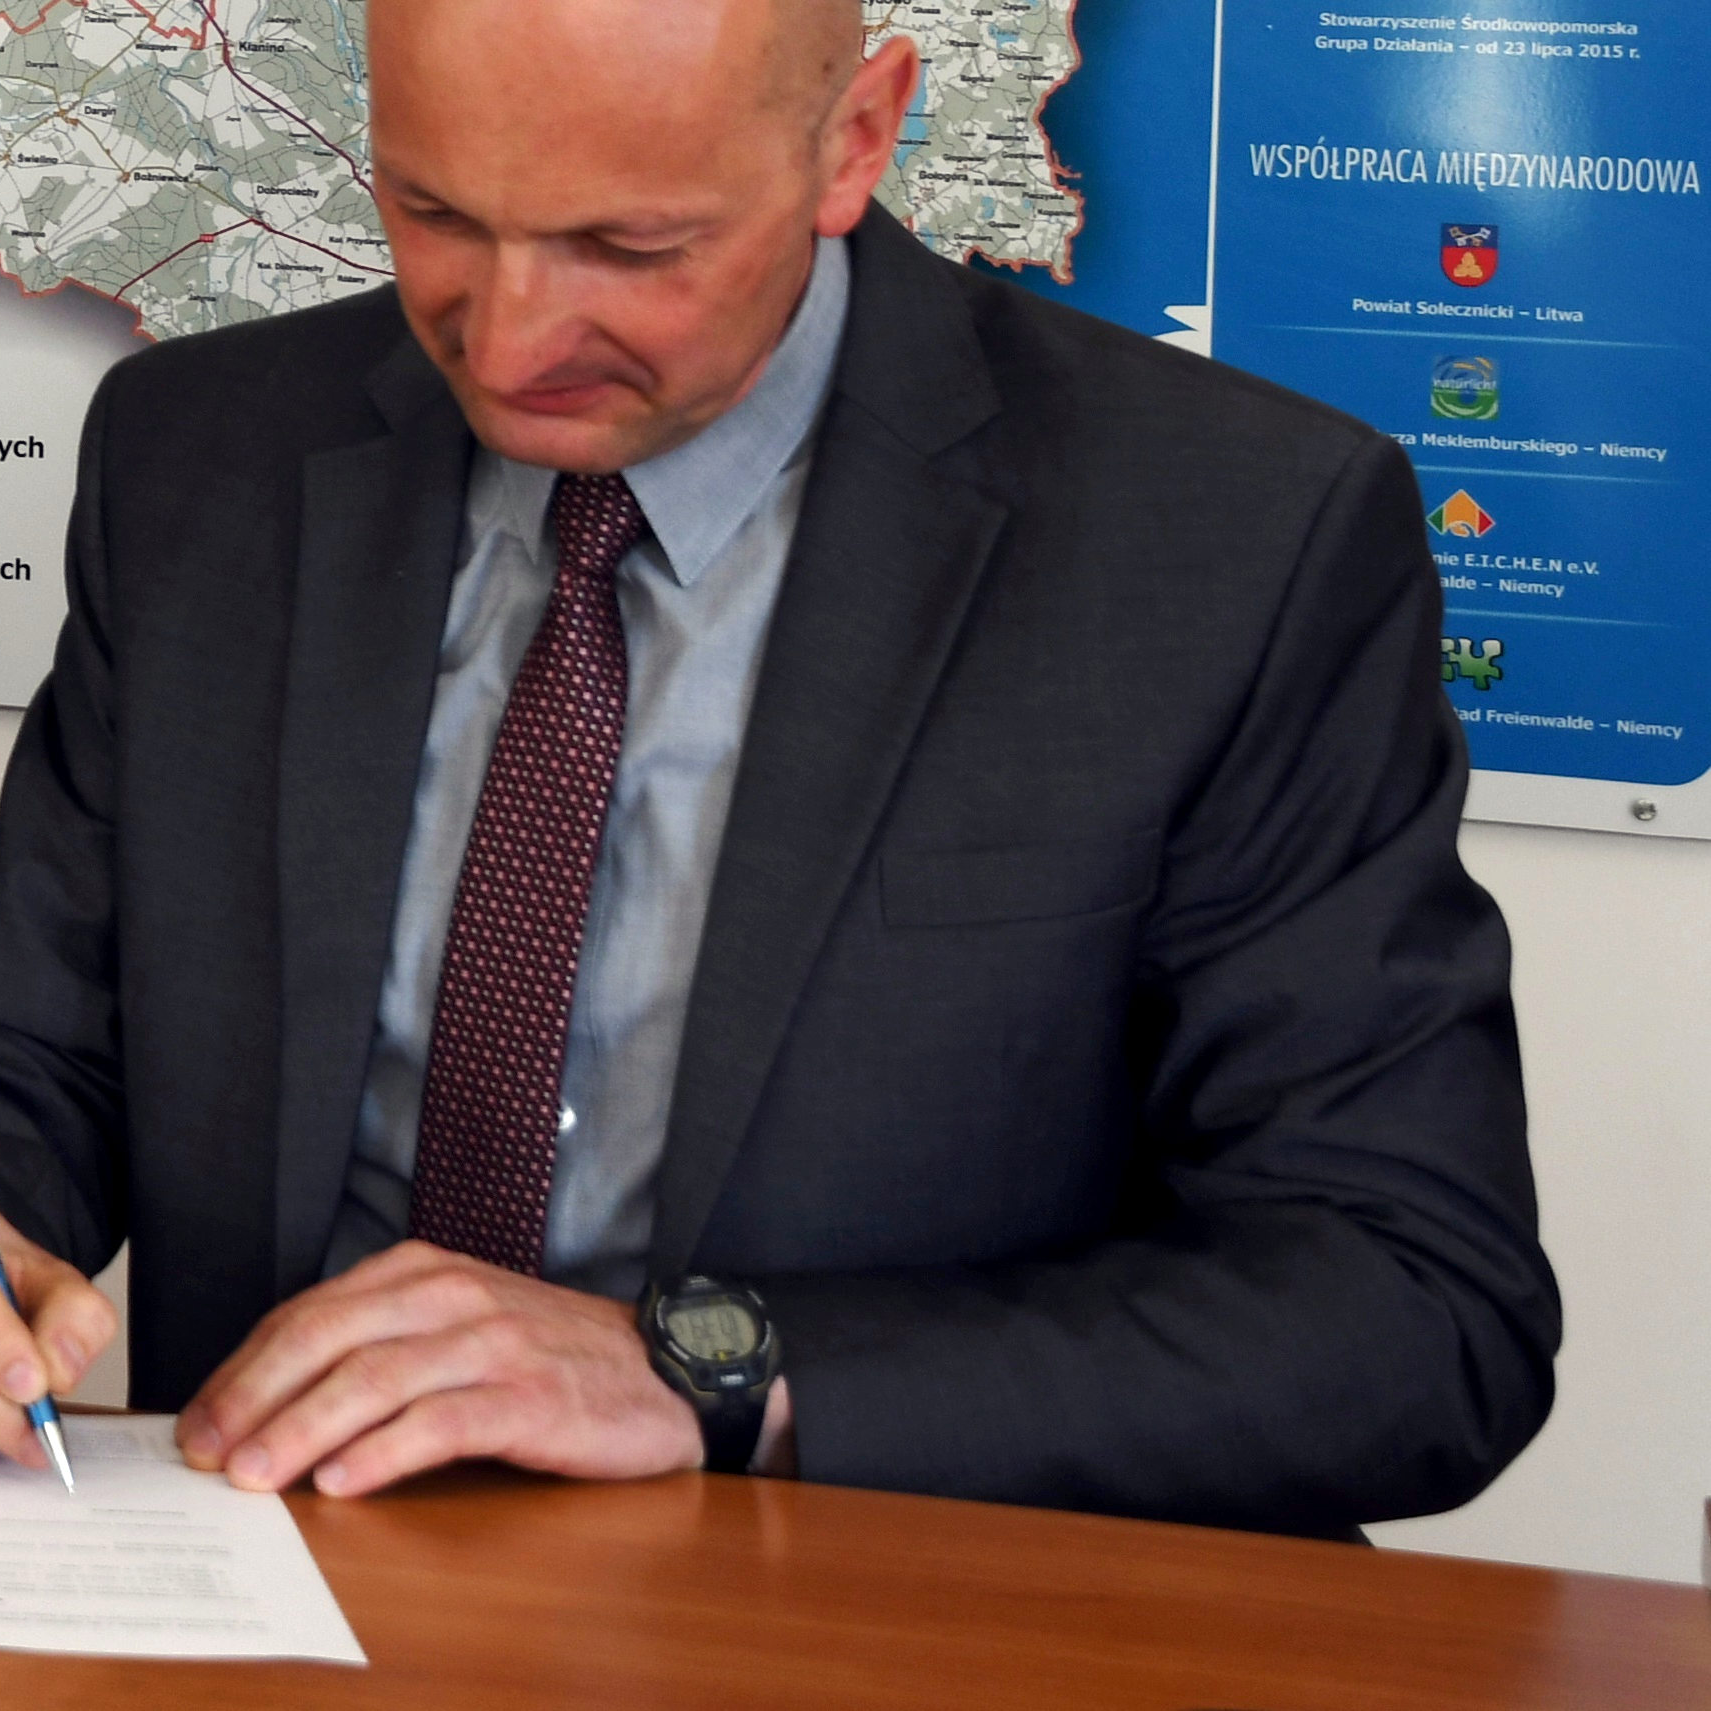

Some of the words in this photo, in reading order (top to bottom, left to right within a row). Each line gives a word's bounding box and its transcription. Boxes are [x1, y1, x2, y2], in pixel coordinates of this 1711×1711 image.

[1319, 12, 1456, 31] Stowarzyszenie
[1461, 13, 1638, 36] Środkowopomorska
[1314, 35, 1369, 53] Grupa
[1373, 37, 1454, 53] Działania
[1475, 40, 1498, 55] od
[1503, 41, 1526, 56] 23
[1531, 41, 1573, 59] lipca
[1578, 43, 1624, 59] 2015
[1629, 48, 1641, 59] r.
[84, 104, 117, 118] Dargin
[16, 151, 58, 165] Świelino
[1249, 136, 1428, 183] WSPÓŁPRACA
[1435, 151, 1700, 195] MIĘDZYNARODOWA
[256, 184, 320, 199] Dobrociechy
[1352, 298, 1412, 314] Powiat
[1416, 301, 1514, 319] Solecznicki
[1535, 306, 1584, 322] Litwa
[1421, 432, 1579, 457] Meklemburskiego
[1600, 442, 1667, 462] Niemcy
[1464, 553, 1563, 573] E.I.C.H.E.N
[1566, 561, 1600, 575] e.V.
[1440, 576, 1476, 589] alde
[1498, 578, 1565, 598] Niemcy
[1485, 709, 1594, 731] Freienwalde
[1616, 719, 1683, 740] Niemcy
